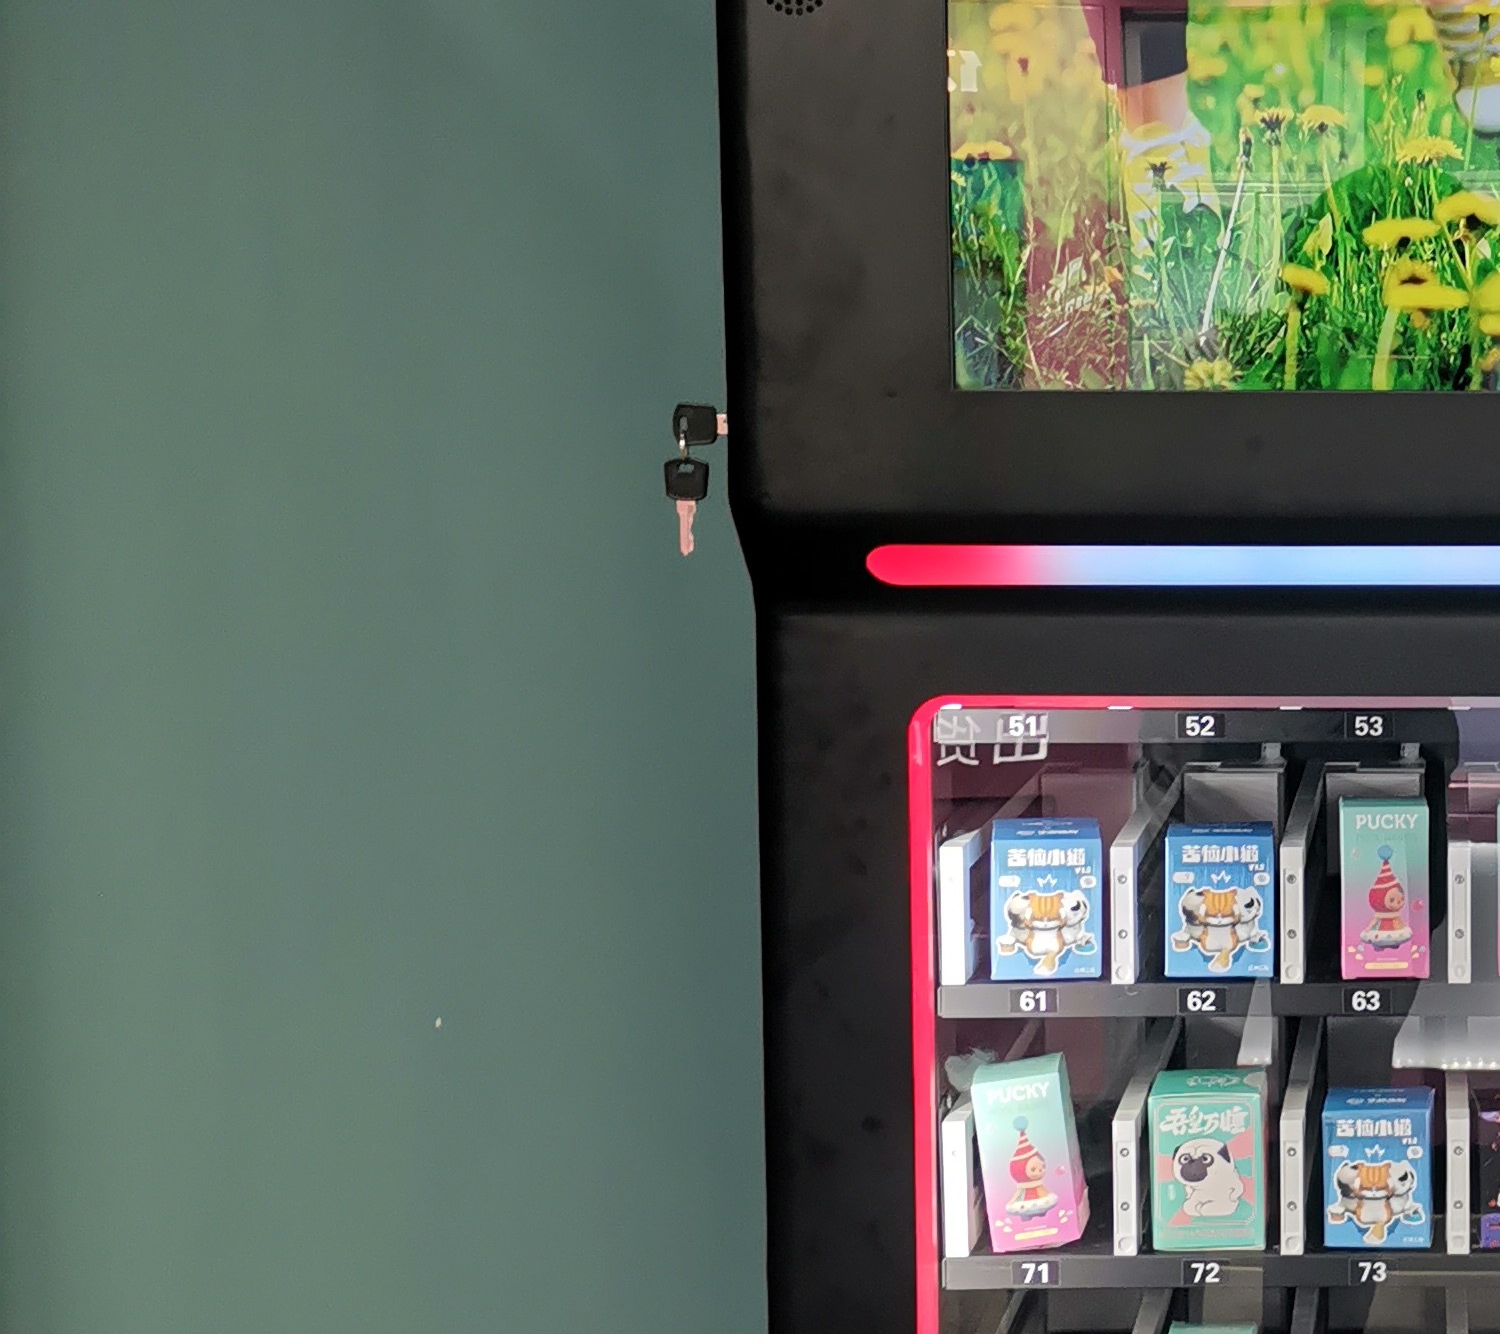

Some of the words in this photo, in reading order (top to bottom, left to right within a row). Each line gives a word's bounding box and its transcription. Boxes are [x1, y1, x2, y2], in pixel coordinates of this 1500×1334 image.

[1008, 715, 1037, 737] 51
[1185, 716, 1215, 737] 52
[1354, 716, 1383, 737] 53
[1355, 813, 1419, 830] PUCKY
[1019, 990, 1048, 1012] 61
[1186, 990, 1216, 1012] 62
[1351, 990, 1381, 1012] 63
[986, 1081, 1050, 1106] PUCKY
[1021, 1263, 1049, 1284] 71
[1190, 1263, 1220, 1284] 72
[1358, 1262, 1387, 1282] 73
